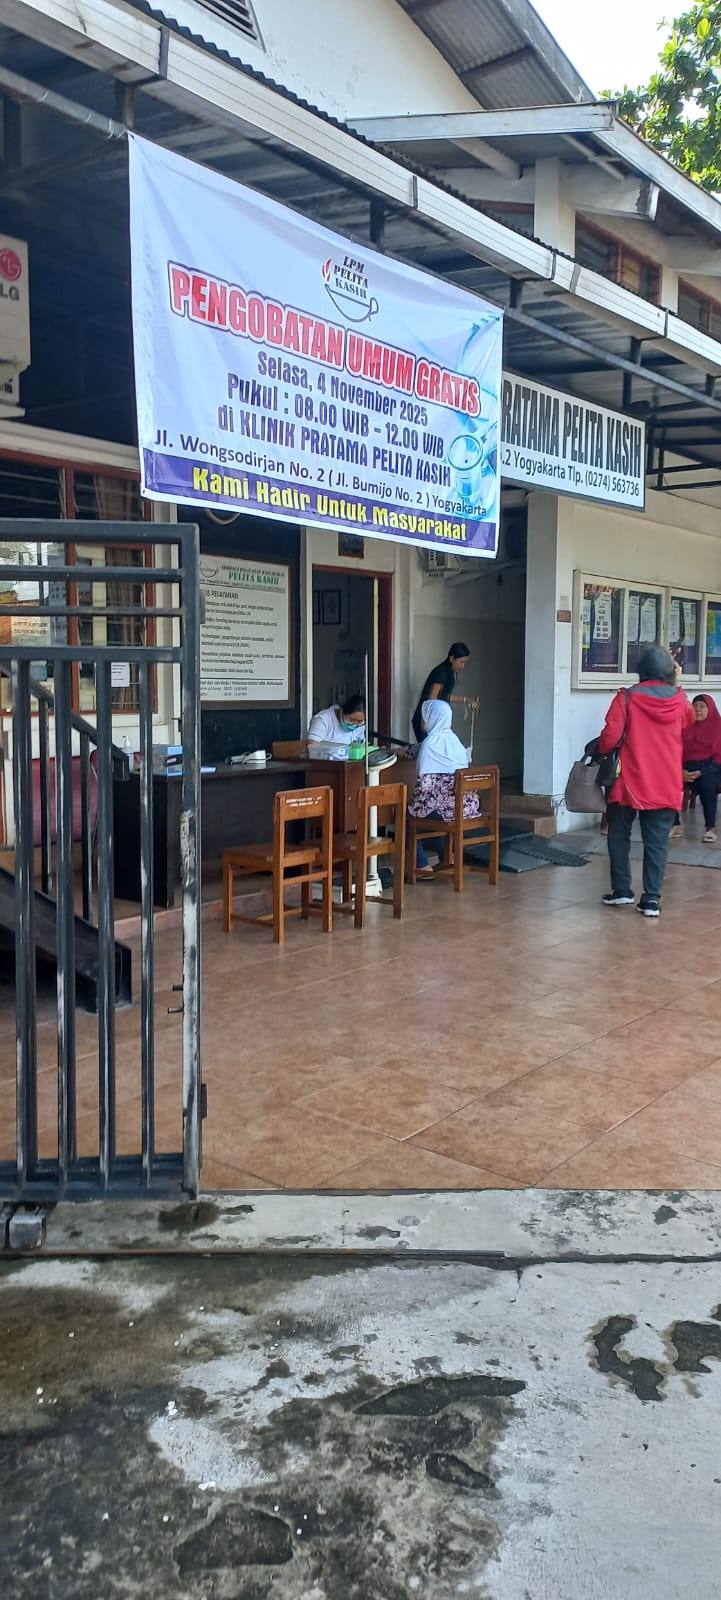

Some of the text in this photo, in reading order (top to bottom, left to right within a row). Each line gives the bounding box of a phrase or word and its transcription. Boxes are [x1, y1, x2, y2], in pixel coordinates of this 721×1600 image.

[0, 283, 20, 301] LG
[334, 265, 368, 288] PELITA
[336, 278, 367, 299] KASIH
[343, 256, 364, 273] LPM
[170, 266, 479, 414] PENGOBATAN UMUM GRATIS
[228, 372, 278, 411] Pukul
[284, 392, 289, 414] :
[294, 393, 337, 428] 08.00
[342, 407, 369, 437] WIB
[385, 422, 419, 451] 12.00
[422, 432, 444, 459] WIB
[257, 350, 428, 426] Selasa, 4 November 2025
[218, 404, 451, 487] di KLINIK PRATAMA PELITA KASIH
[501, 379, 642, 478] RATAMA PELITA KASIH
[154, 429, 173, 448] Jl.
[180, 433, 285, 473] Wongsodirjan
[289, 461, 313, 480] No.
[317, 468, 325, 482] 2
[335, 472, 349, 488] Jl.
[352, 477, 392, 501] Bumijo
[395, 487, 413, 504] No.
[416, 491, 423, 504] 2
[432, 494, 487, 516] Yogyakarta
[192, 466, 467, 541] Kami Hadir Untuk Masyarakat
[513, 450, 566, 480] Yogyakarta
[568, 465, 583, 486] Tlp.
[585, 469, 611, 492] (0274)
[612, 477, 640, 497] 563736
[228, 571, 279, 585] PELITA KASIH
